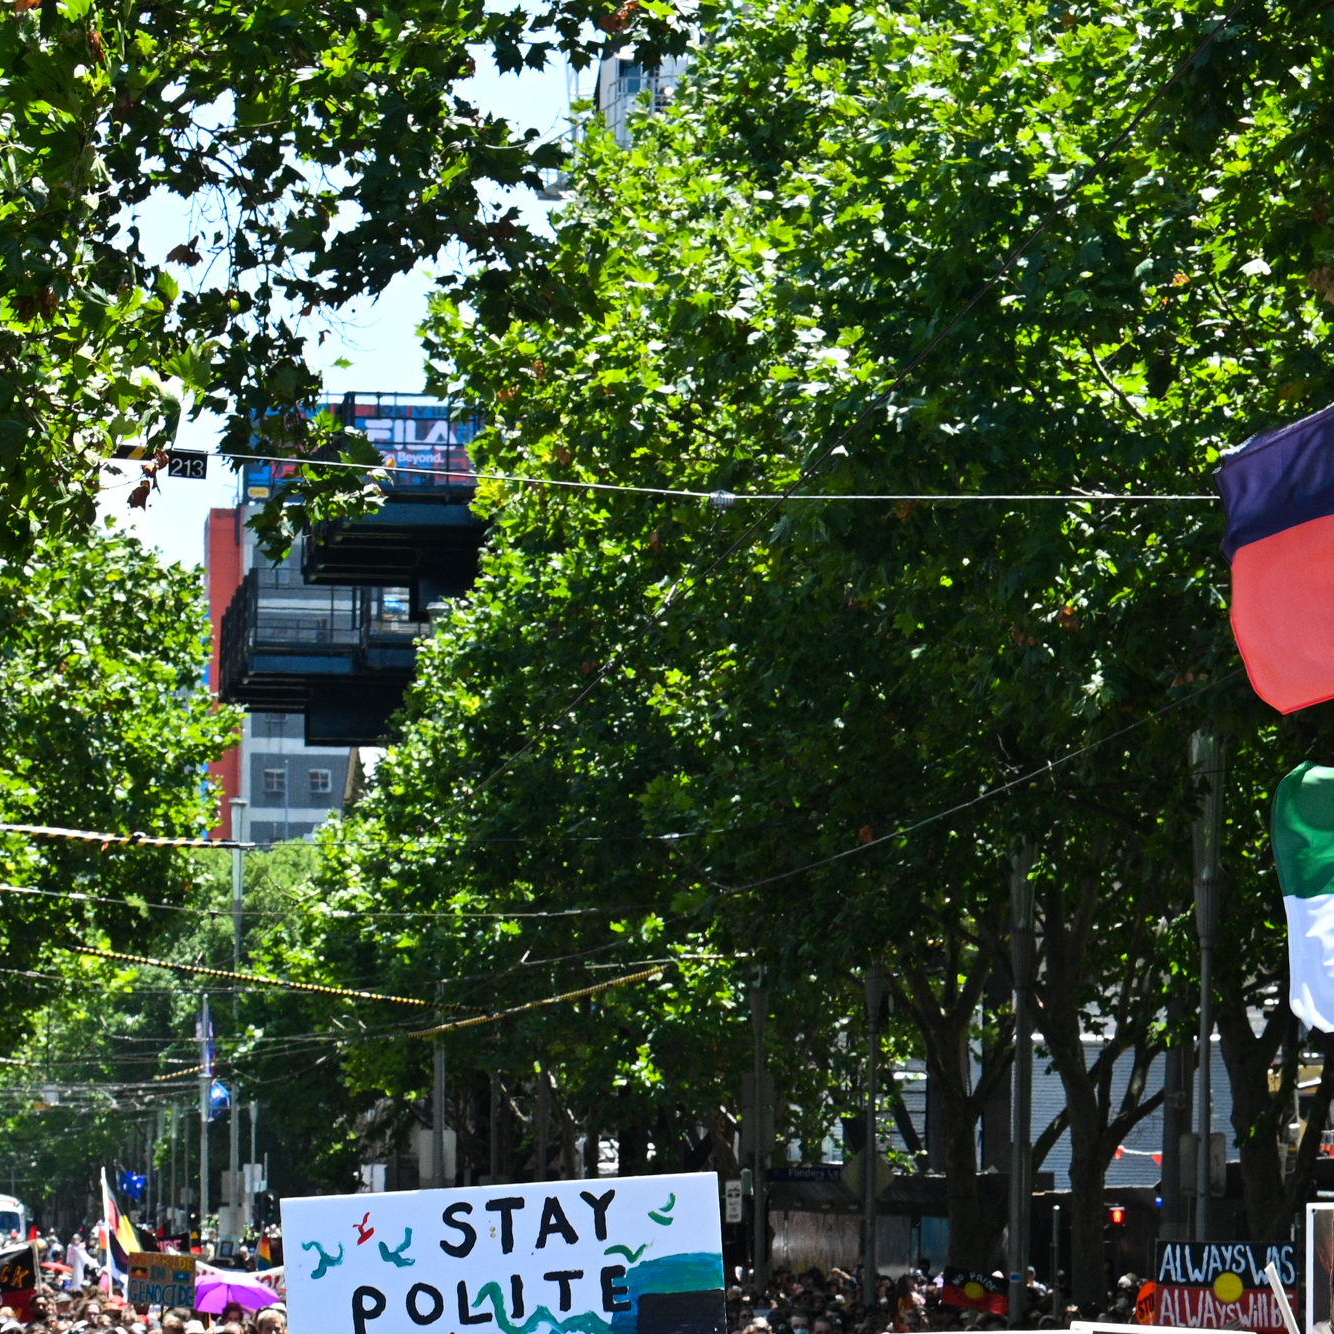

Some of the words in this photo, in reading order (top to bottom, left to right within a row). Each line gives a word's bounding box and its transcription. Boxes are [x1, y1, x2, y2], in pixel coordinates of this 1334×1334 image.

[365, 418, 457, 451] FILA
[171, 457, 204, 478] 213
[398, 451, 444, 465] Beyond.
[788, 1168, 824, 1177] Flinders
[439, 1189, 616, 1259] STAY
[153, 1256, 193, 1271] PRIDE
[1159, 1243, 1246, 1283] ALWAYS
[1245, 1244, 1296, 1286] WAS
[129, 1280, 194, 1307] GENOCIDE
[1137, 1293, 1155, 1319] STO
[1159, 1289, 1238, 1328] ALWAYS
